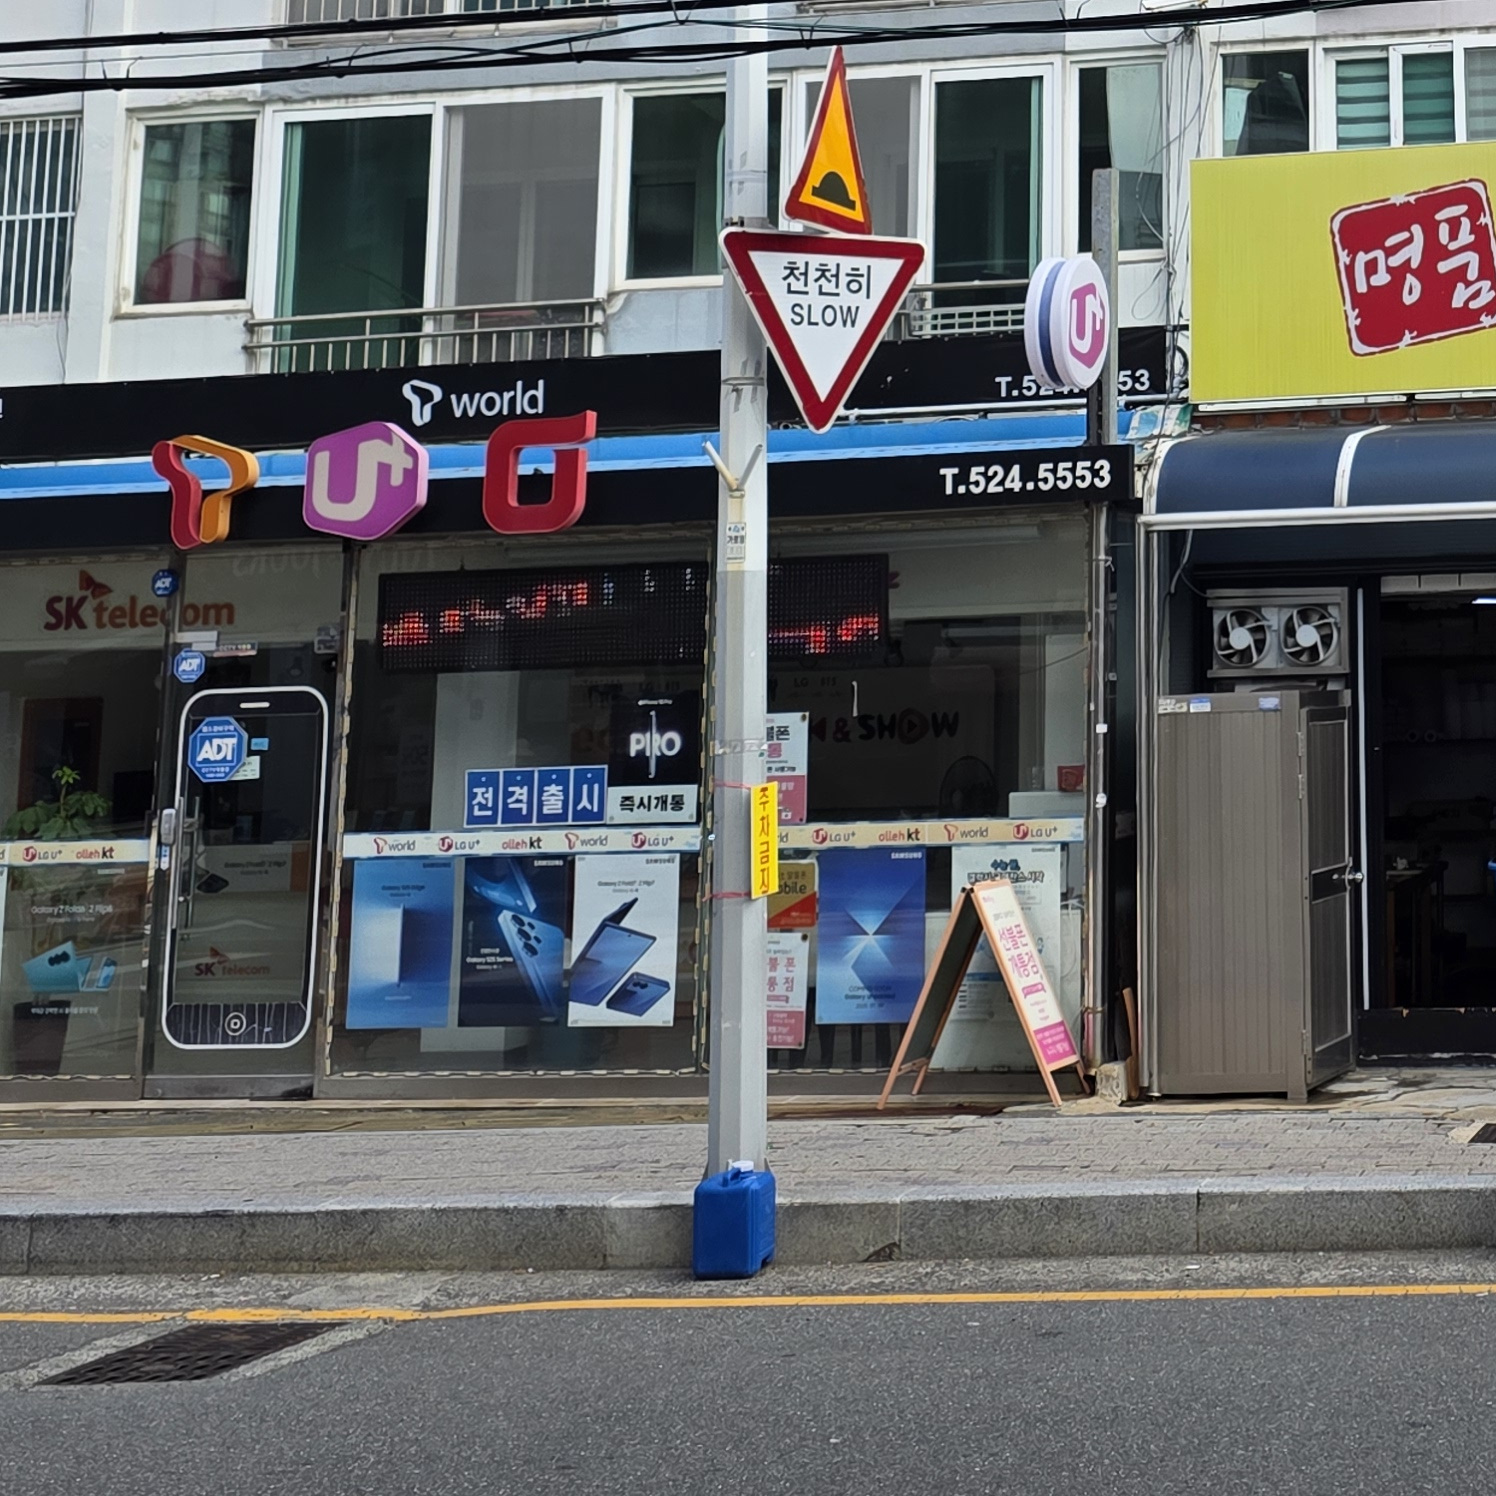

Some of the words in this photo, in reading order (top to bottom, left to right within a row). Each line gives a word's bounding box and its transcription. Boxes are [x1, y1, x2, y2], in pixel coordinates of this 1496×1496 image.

[1353, 204, 1496, 310] 명품
[781, 260, 873, 300] 천천히
[790, 303, 860, 329] SLOW
[450, 380, 545, 417] world
[940, 460, 1112, 496] T.524.5553
[154, 577, 172, 589] ADT
[44, 595, 89, 631] SK
[178, 658, 201, 672] ADT
[196, 737, 238, 762] ADT
[629, 730, 682, 757] PRO
[470, 783, 600, 816] 전격출시
[619, 794, 685, 813] 즉시개통
[388, 839, 416, 852] world
[455, 841, 467, 850] LG
[502, 839, 528, 850] olleh
[529, 836, 542, 849] kt
[580, 835, 608, 847] world
[647, 837, 659, 847] LG
[758, 786, 770, 895] 주차금지
[829, 833, 842, 841] LG
[878, 830, 905, 842] olleh
[906, 827, 920, 841] kt
[960, 826, 988, 838] world
[1030, 828, 1043, 838] LG
[38, 851, 50, 861] LG
[75, 849, 100, 860] olleh
[101, 846, 115, 859] kt
[194, 962, 216, 977] SK
[221, 964, 270, 976] telecom
